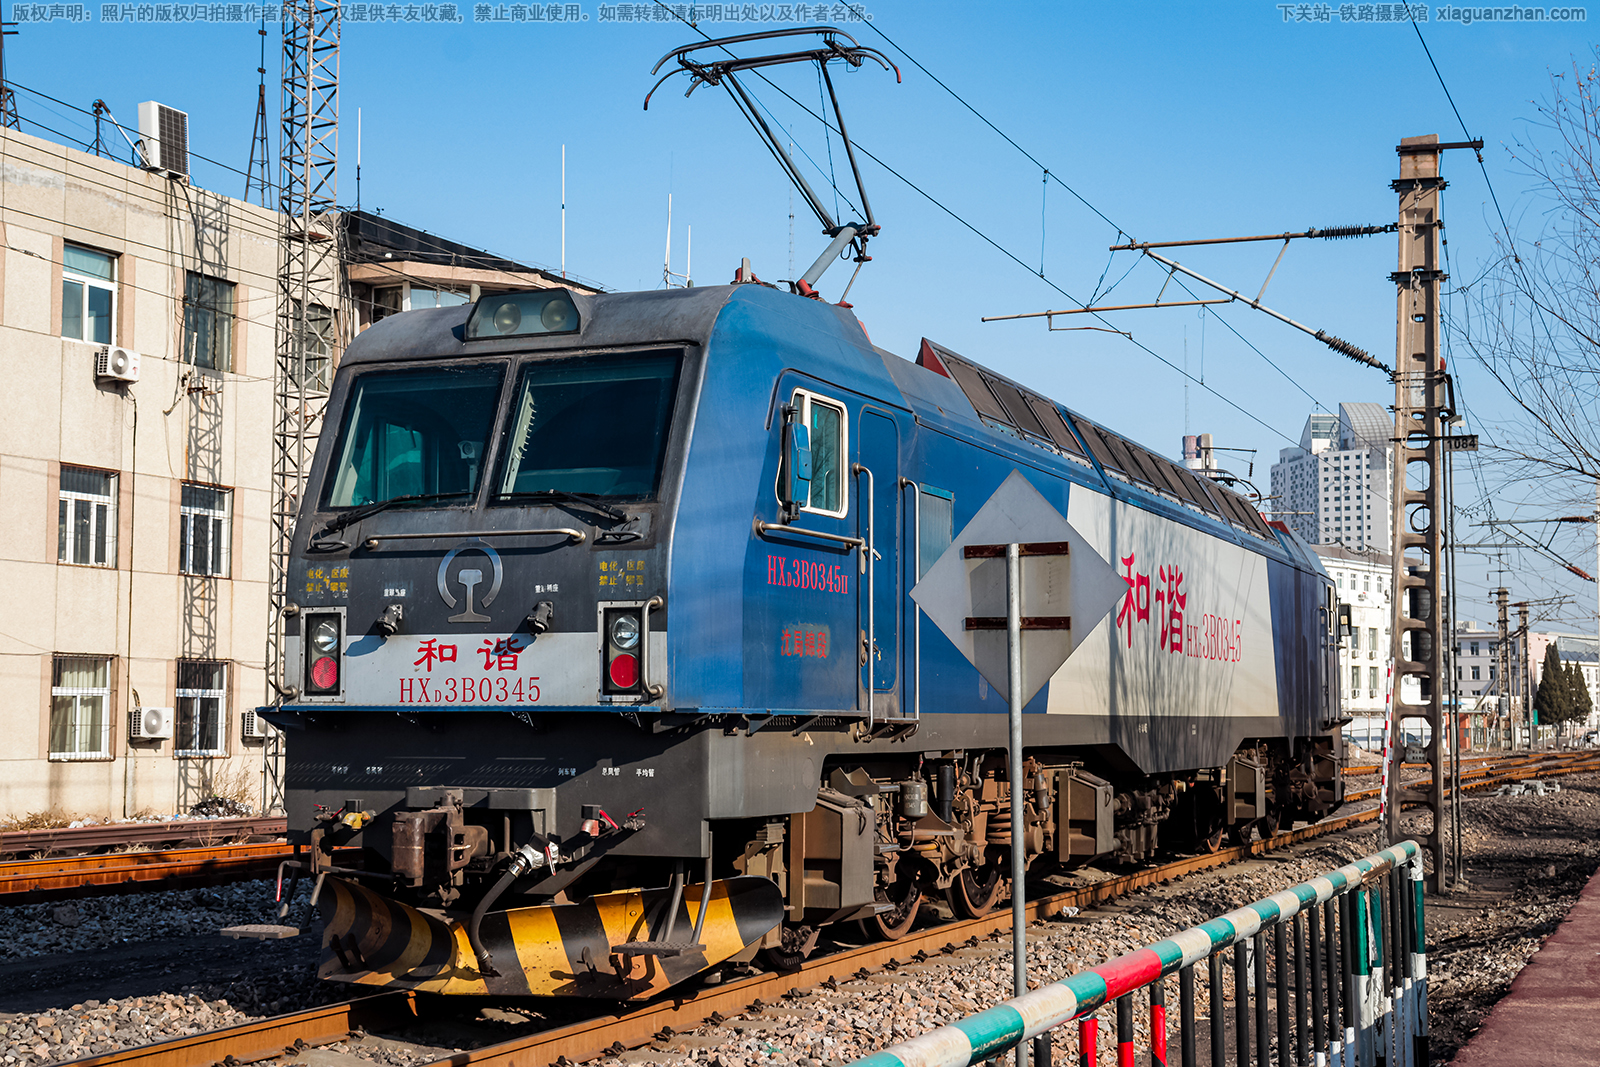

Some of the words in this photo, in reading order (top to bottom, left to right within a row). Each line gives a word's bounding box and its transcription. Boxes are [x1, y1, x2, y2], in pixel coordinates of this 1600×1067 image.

[1447, 438, 1476, 449] 1084
[1116, 552, 1187, 654] 和谐
[413, 637, 525, 672] 和谐
[399, 677, 541, 702] HXD3B0345
